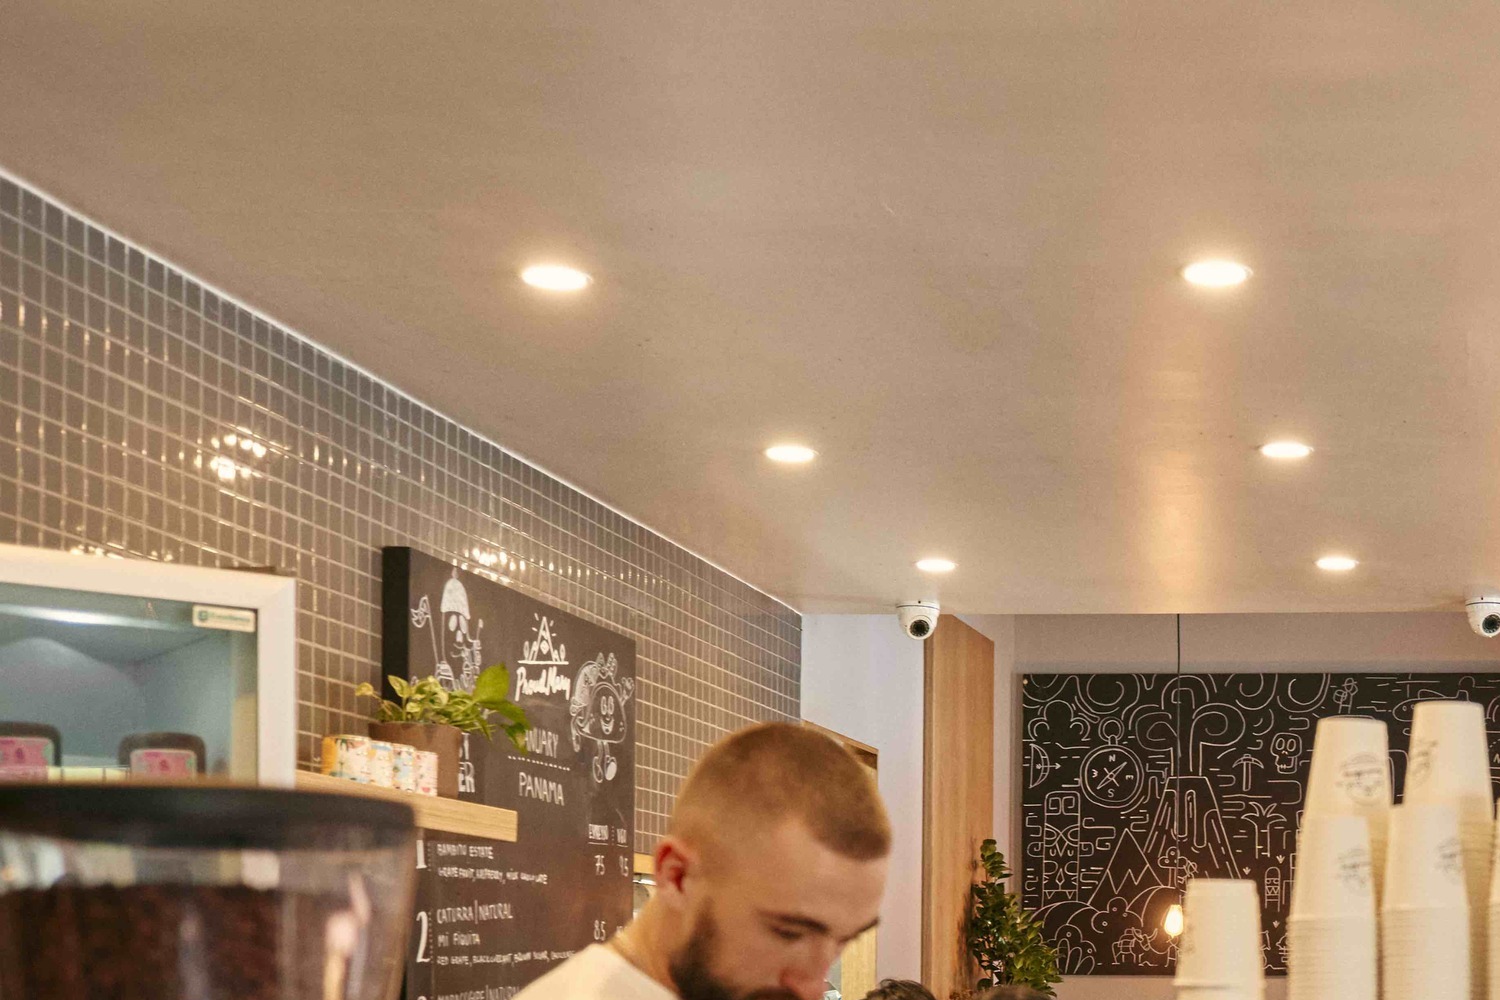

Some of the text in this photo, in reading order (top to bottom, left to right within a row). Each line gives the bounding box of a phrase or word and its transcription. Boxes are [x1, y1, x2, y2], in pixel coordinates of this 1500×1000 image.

[524, 727, 559, 759] ANUARY
[1109, 754, 1116, 762] N
[519, 772, 565, 806] PANAMA
[1107, 789, 1115, 798] S
[416, 911, 431, 963] 2
